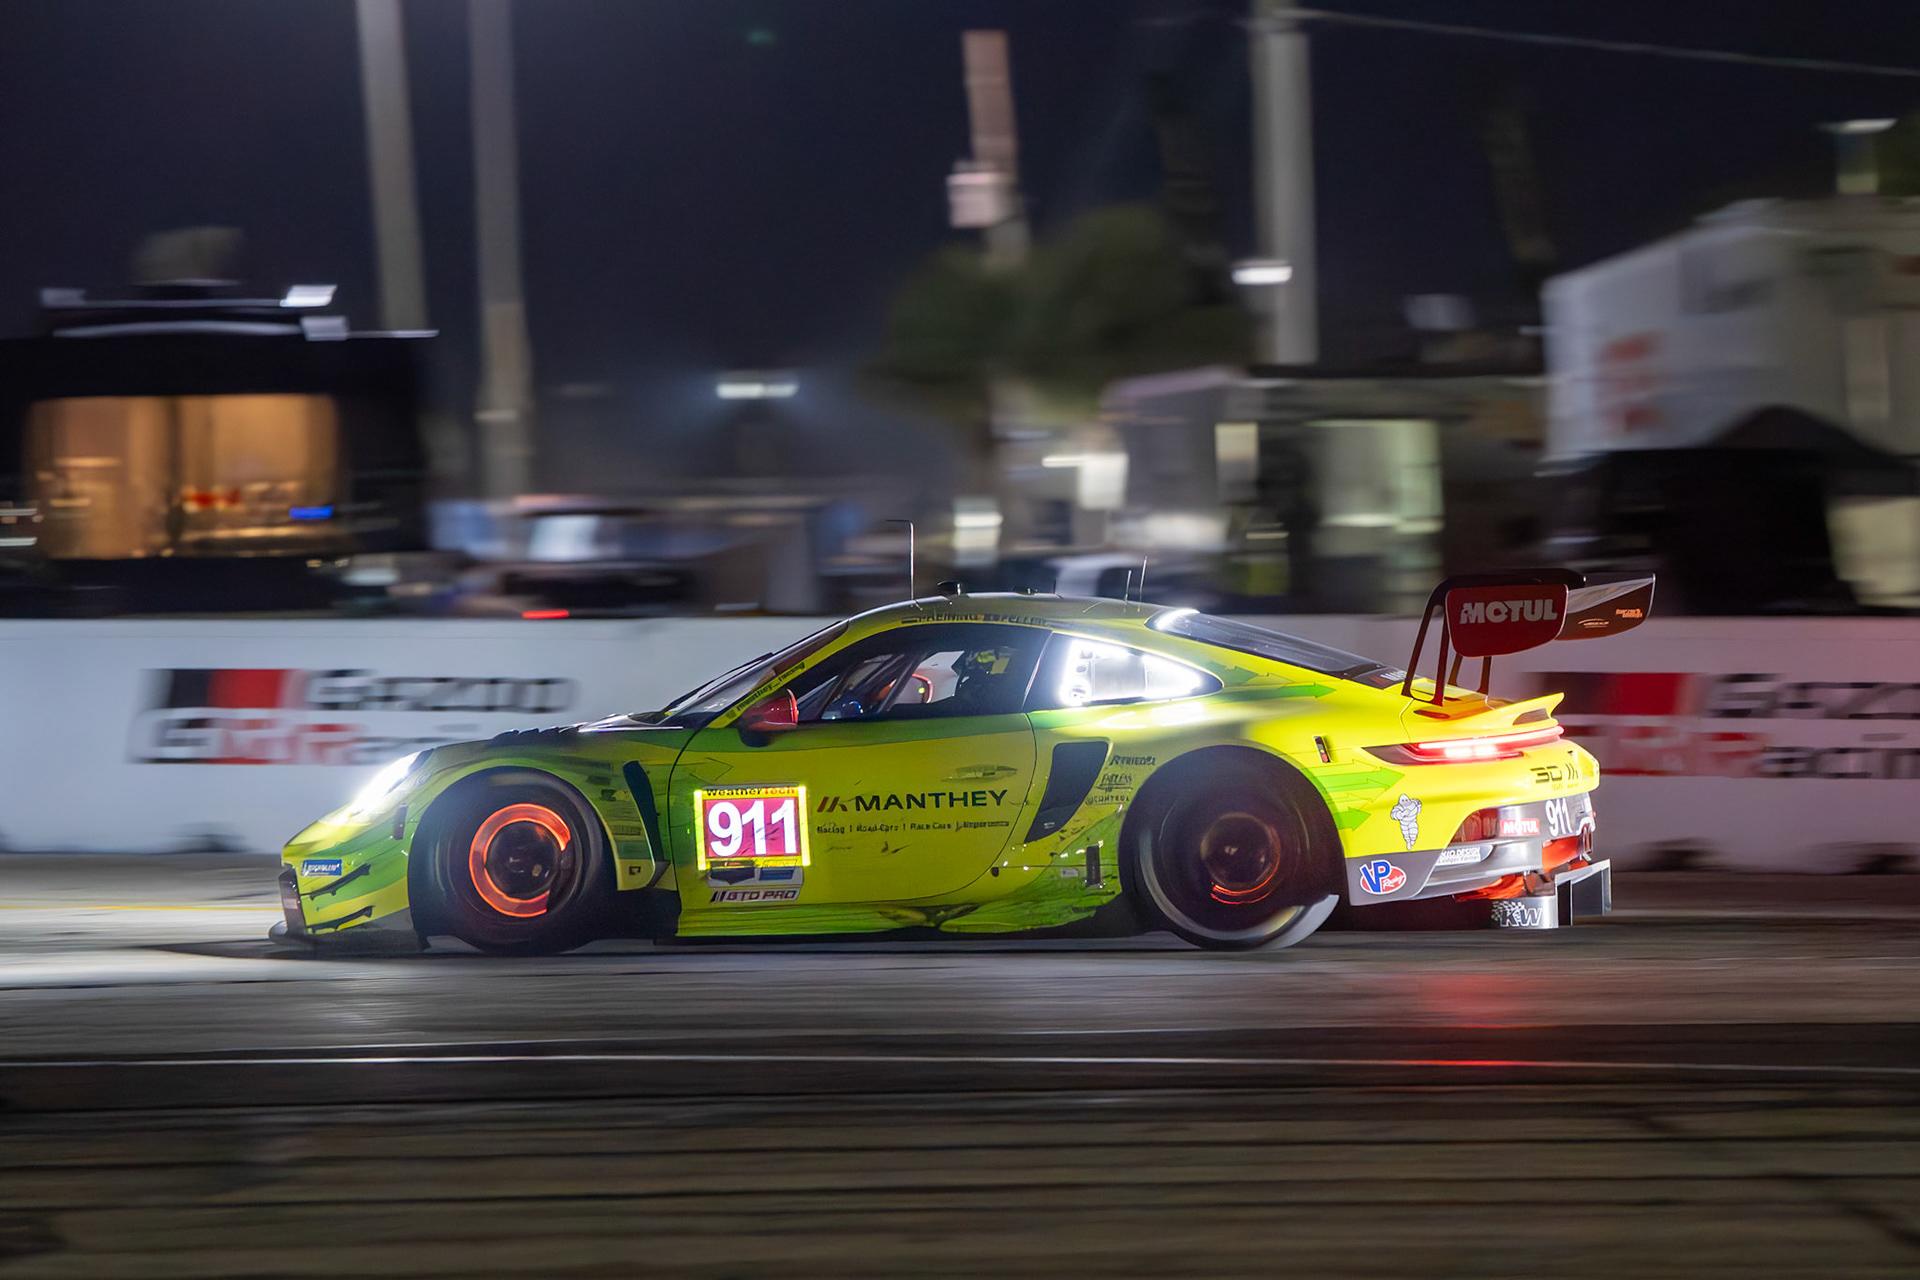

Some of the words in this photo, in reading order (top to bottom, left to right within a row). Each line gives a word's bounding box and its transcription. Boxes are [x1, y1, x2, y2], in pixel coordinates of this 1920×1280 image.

[1459, 598, 1558, 624] MOTUL
[855, 789, 1008, 812] MANTHEY
[708, 799, 797, 857] 911
[1503, 821, 1538, 835] MOTUL
[1546, 798, 1573, 836] 911
[1360, 861, 1391, 893] VP
[726, 890, 760, 901] GTD
[762, 890, 797, 900] PRO
[1500, 908, 1542, 927] KW
